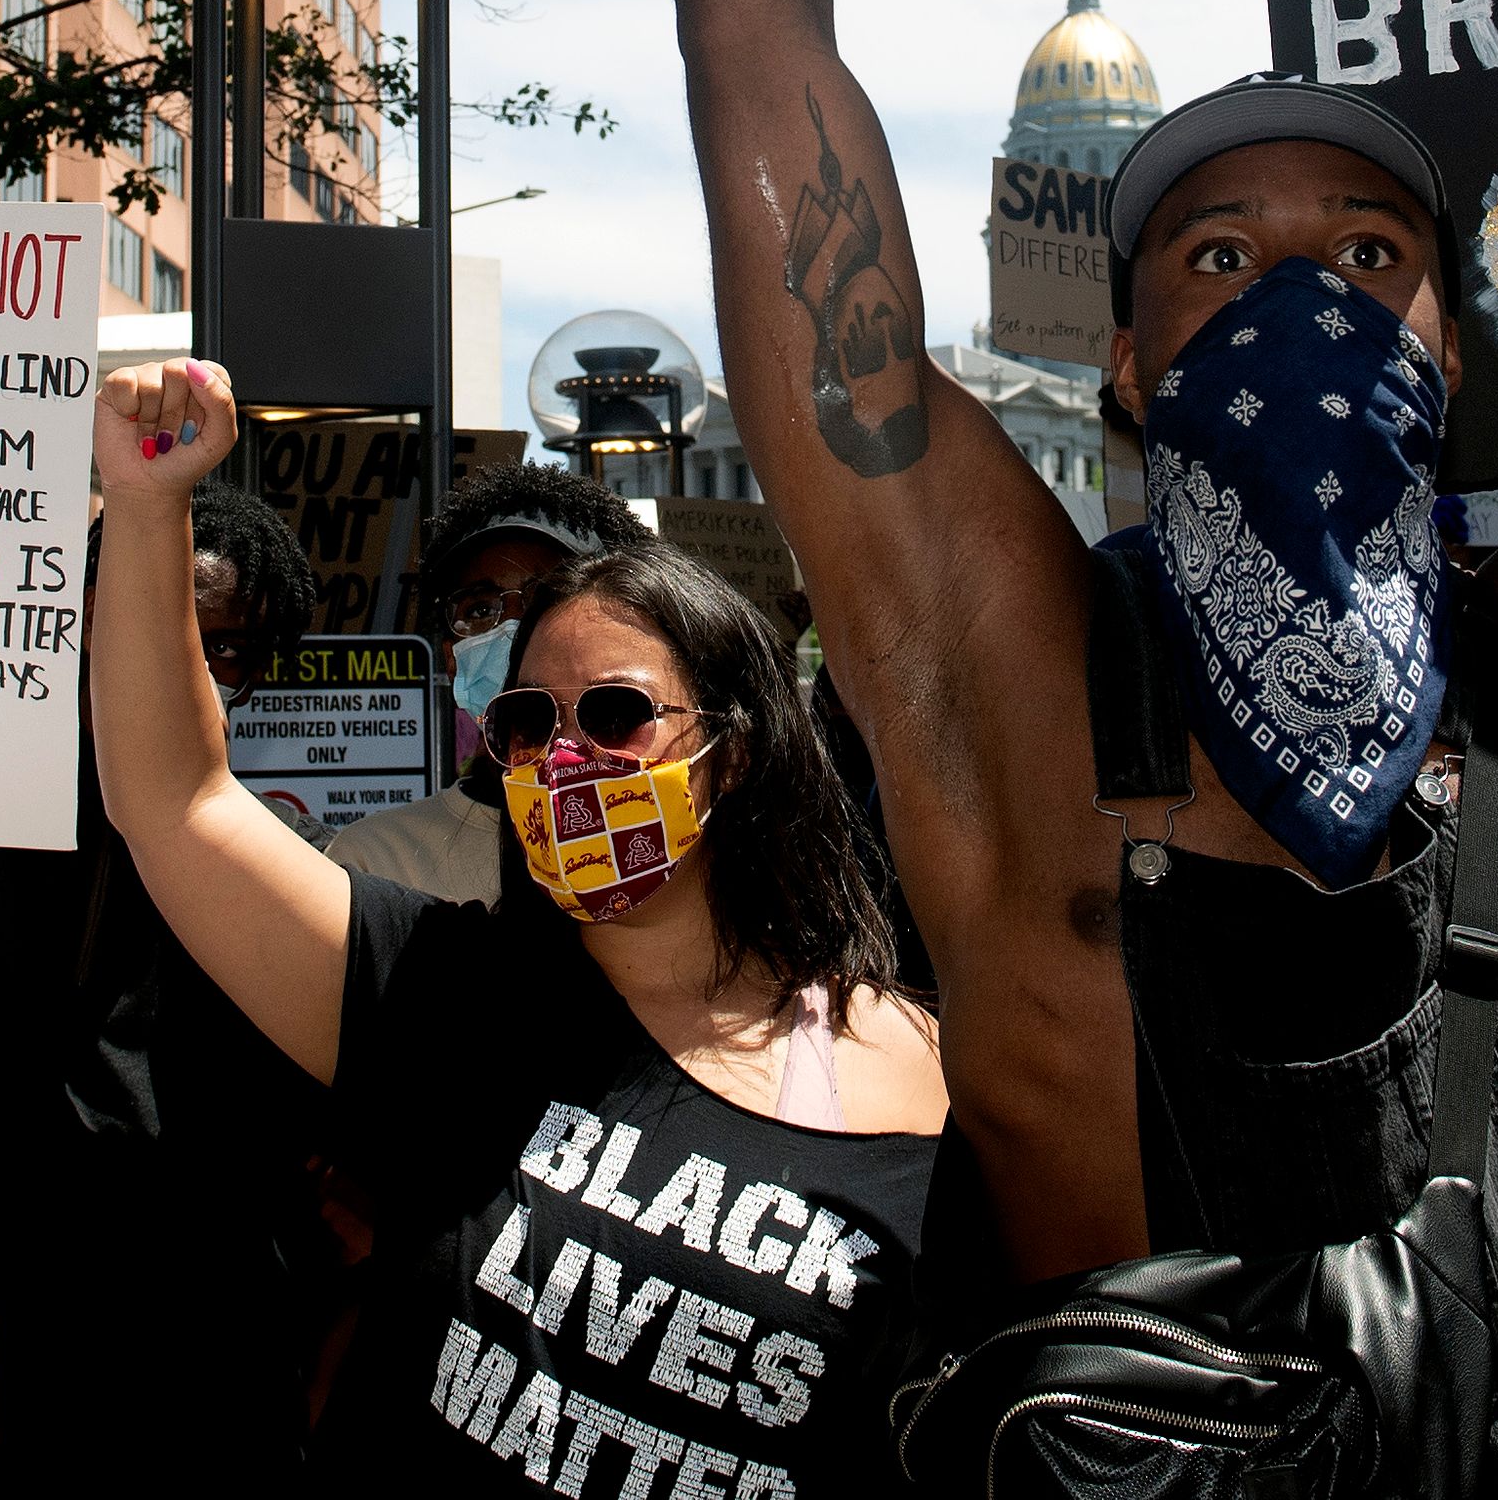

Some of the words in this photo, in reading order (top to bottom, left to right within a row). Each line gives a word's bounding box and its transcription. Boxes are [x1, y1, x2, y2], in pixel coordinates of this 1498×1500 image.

[1000, 230, 1109, 284] DIFFERE
[260, 431, 346, 496] OU
[17, 544, 67, 593] IS
[298, 650, 338, 682] ST.
[347, 650, 421, 681] MALL
[251, 694, 363, 712] PEDESTRIANS
[367, 694, 401, 711] AND
[234, 720, 336, 738] AUTHORIZED
[342, 719, 417, 737] VEHICLES
[306, 746, 348, 764] ONLY
[327, 789, 356, 804] WALK
[359, 788, 386, 803] YOUR
[389, 788, 412, 803] BIKE
[520, 1100, 880, 1310] BLACK
[475, 1202, 826, 1428] LIVES
